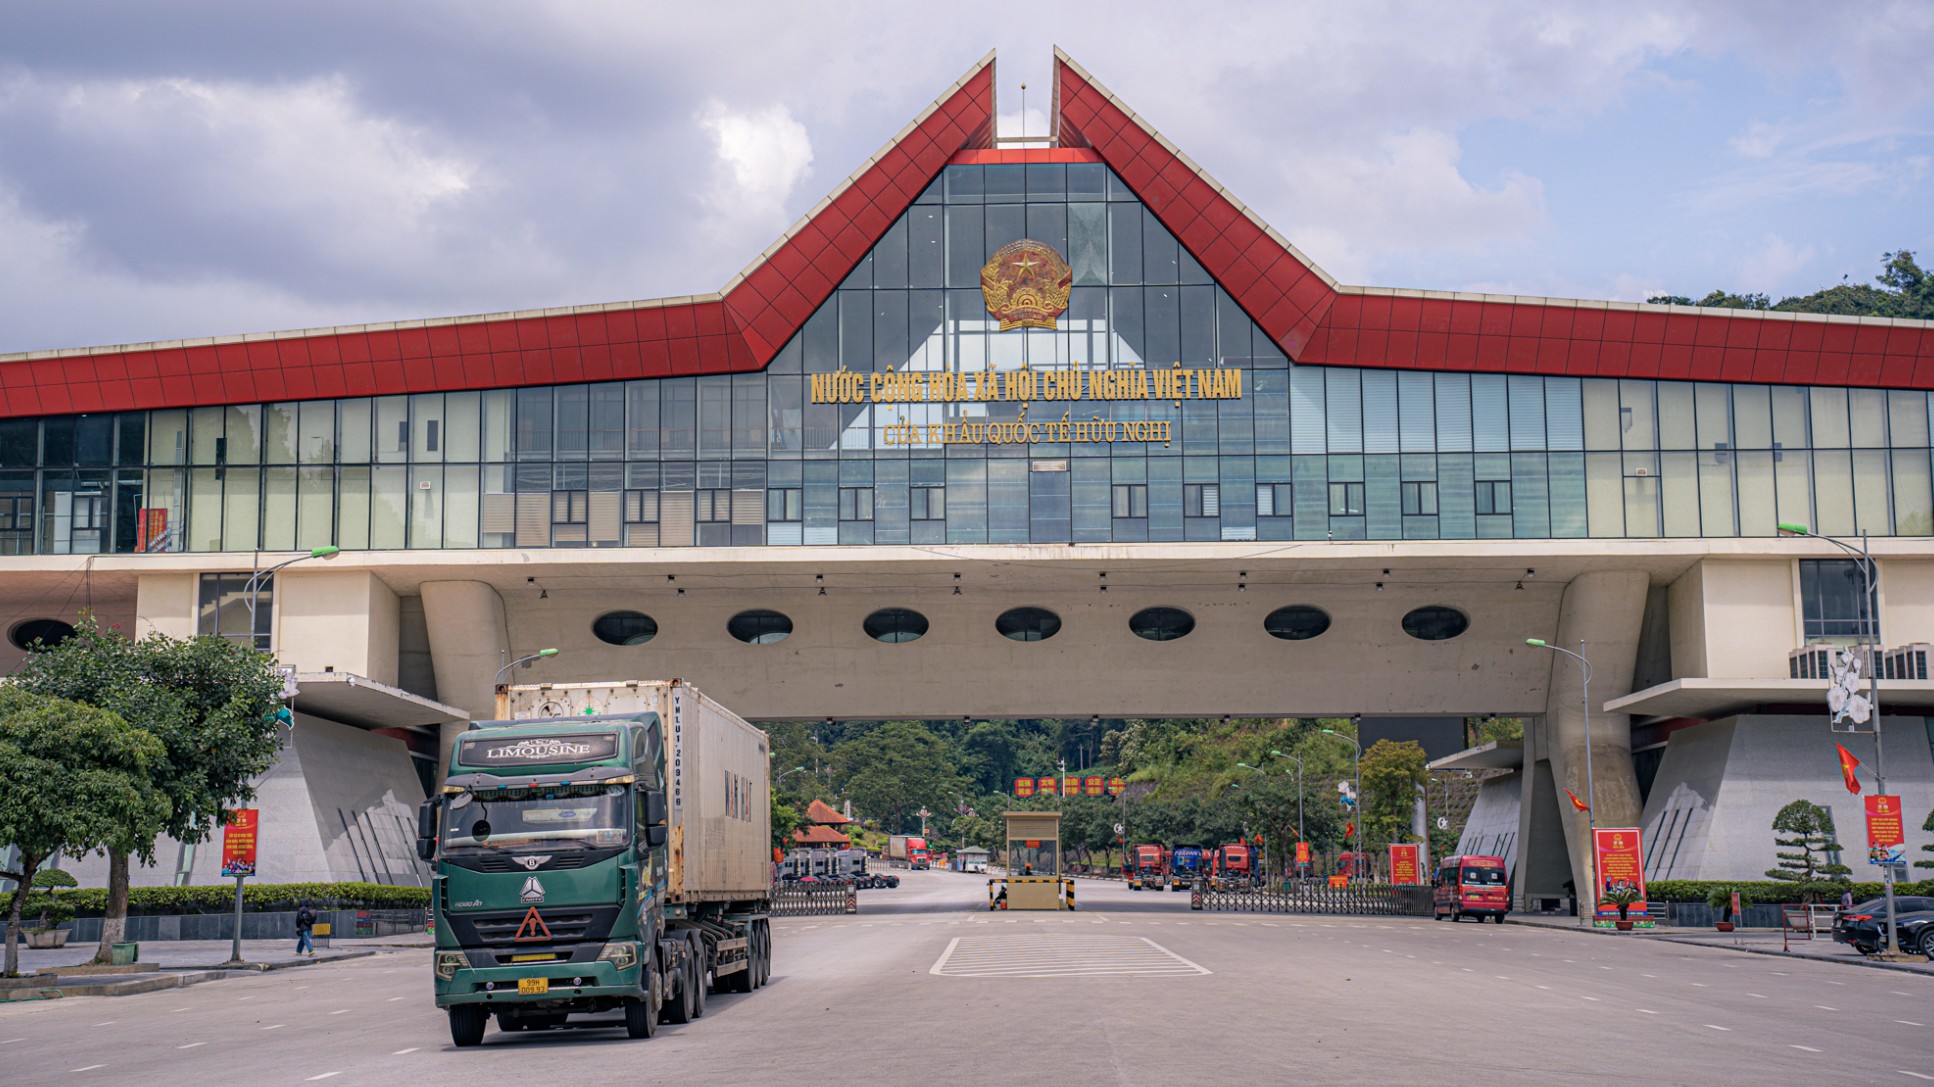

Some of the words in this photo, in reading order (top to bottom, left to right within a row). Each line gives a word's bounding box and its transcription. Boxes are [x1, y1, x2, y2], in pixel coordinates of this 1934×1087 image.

[811, 365, 865, 404] NƯỚC
[870, 365, 924, 410] CỘNG
[929, 363, 969, 402] HÒA
[973, 363, 999, 401] XÃ
[1005, 361, 1038, 409] HỘI
[1043, 360, 1082, 401] CHỦ
[1089, 361, 1149, 401] NGHĨA
[1152, 361, 1193, 408] VIỆT
[1199, 368, 1242, 400] NAM
[883, 415, 921, 445] CỬA
[927, 409, 984, 444] KHẨU
[987, 411, 1041, 445] QUỐC
[1044, 410, 1071, 443] TẾ
[1074, 415, 1117, 443] HỮU
[1121, 420, 1171, 448] NGHỊ
[486, 744, 591, 759] LIMOUSINE
[528, 858, 536, 866] B
